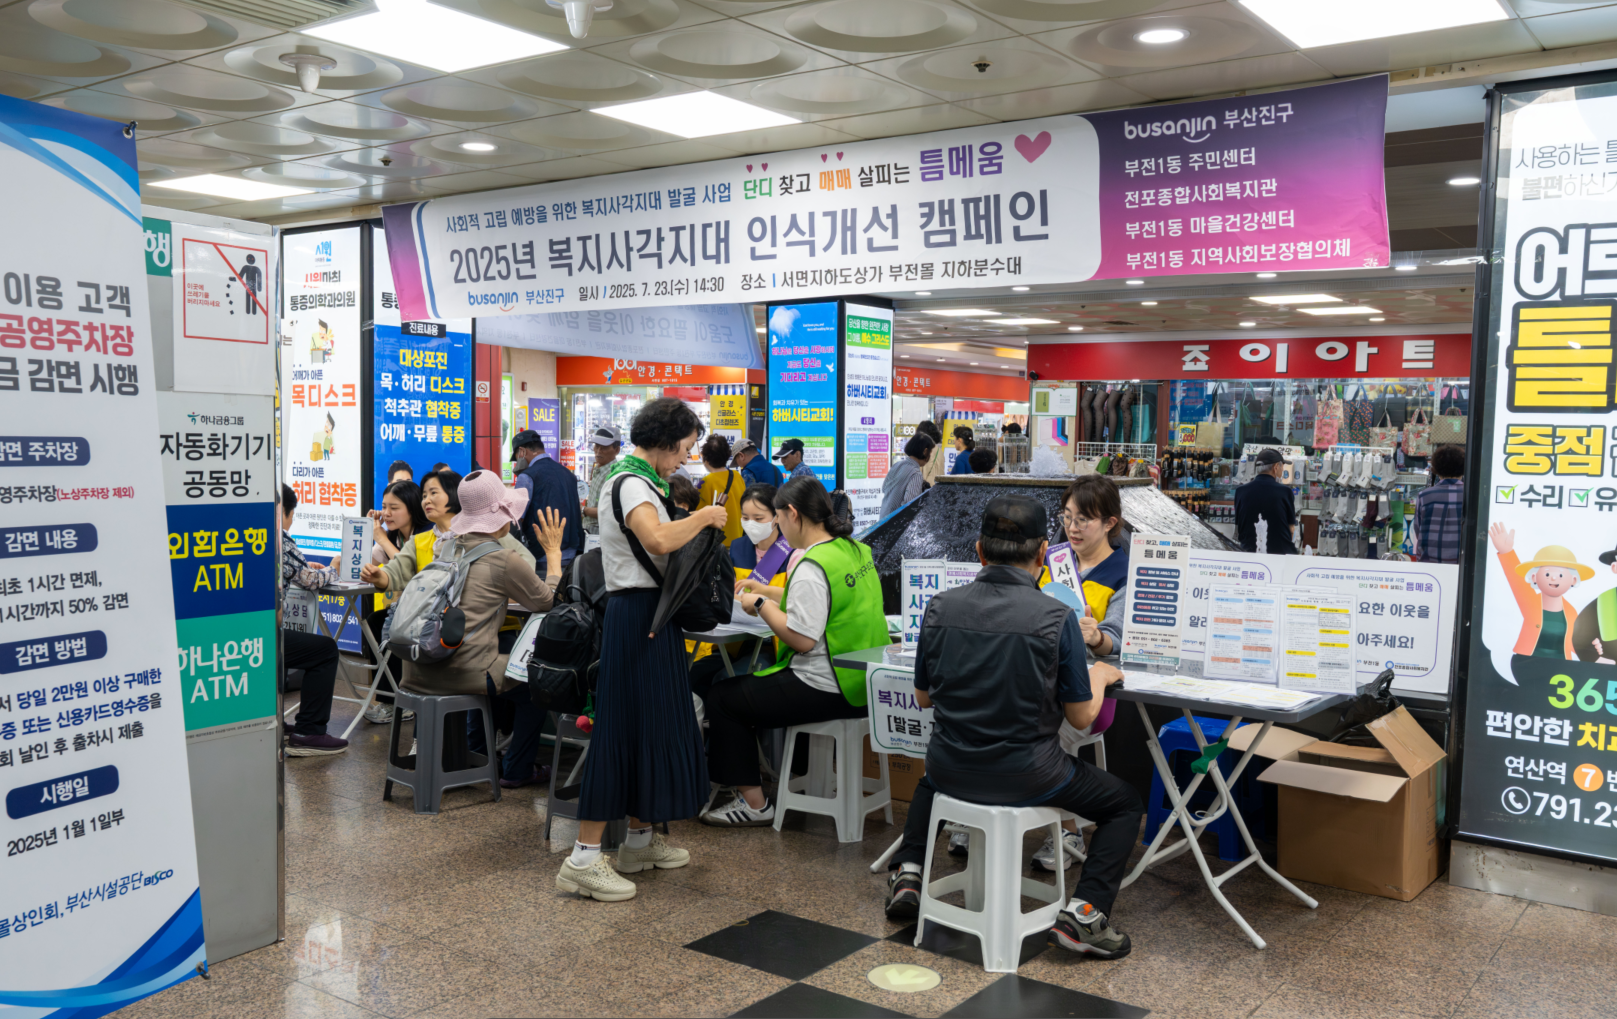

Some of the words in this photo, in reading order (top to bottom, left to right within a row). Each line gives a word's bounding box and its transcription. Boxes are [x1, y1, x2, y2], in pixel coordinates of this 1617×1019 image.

[1124, 115, 1217, 140] busanjin
[1223, 102, 1294, 129] 부산진구
[1125, 155, 1182, 177] 부전1동
[1188, 147, 1256, 172] 주민센터
[1515, 142, 1600, 169] 사용하는
[743, 177, 773, 200] 단디
[779, 173, 811, 196] 찾고
[819, 168, 852, 191] 매매
[857, 162, 910, 188] 살피는
[919, 141, 1004, 182] 틈메움
[1124, 177, 1278, 209] 전포종합사회복지관
[446, 213, 480, 233] 사회적
[484, 210, 507, 228] 고립
[511, 205, 548, 226] 예방을
[552, 201, 577, 221] 위한
[582, 191, 662, 217] 복지사각지대
[667, 187, 696, 208] 발굴
[702, 182, 731, 204] 사업
[450, 240, 537, 284] 2025년
[548, 220, 730, 277] 복지사각지대
[747, 204, 899, 261] 인식개선
[918, 189, 1049, 249] 캠페인
[1126, 218, 1183, 240] 부전1동
[1190, 209, 1295, 234] 마을건강센터
[143, 229, 171, 268] 행
[1126, 249, 1184, 270] 부전1동
[1191, 238, 1351, 266] 지역사회보장협의체
[186, 282, 205, 291] 이곳에
[740, 272, 767, 291] 장소
[781, 265, 883, 289] 서면지하도상가
[888, 262, 934, 283] 부전몰
[940, 256, 1022, 279] 지하분수대
[3, 272, 64, 311] 이용
[77, 281, 132, 318] 고객
[186, 291, 210, 299] 쓰레기를
[290, 291, 356, 311] 통증의학과의원
[468, 291, 519, 308] busanjin
[525, 288, 565, 305] 부산진구
[578, 285, 599, 302] 일시
[609, 283, 638, 299] 2025.
[641, 282, 651, 296] 7.
[694, 276, 725, 293] 14:30
[409, 322, 439, 336] 진료내용
[400, 349, 448, 369] 대상포진
[1506, 301, 1617, 414] 틀
[28, 358, 83, 394] 감면
[90, 363, 139, 397] 시행
[430, 376, 465, 394] 디스크
[780, 371, 806, 382] 기다리고
[291, 384, 357, 408] 목디스크
[384, 398, 422, 418] 척추관
[426, 400, 461, 420] 협착증
[200, 415, 244, 426] 하나금융그룹
[533, 408, 555, 422] SALE
[772, 407, 834, 422] 하버시티교회!
[159, 432, 271, 461] 자동화기기
[442, 425, 465, 444] 통증
[28, 441, 79, 462] 주차장
[1503, 423, 1607, 477] 중점
[183, 469, 251, 498] 공동망
[292, 466, 311, 478] 다리가
[112, 485, 135, 499] 제외)
[292, 481, 316, 505] 허리
[318, 482, 357, 507] 협착증
[1519, 484, 1563, 509] 수리
[5, 531, 40, 553] 감면
[45, 528, 78, 549] 내용
[167, 527, 268, 560] 외환은행
[28, 573, 65, 593] 1시간
[69, 570, 103, 590] 면제,
[193, 562, 244, 592] ATM
[908, 573, 939, 590] 복지
[1241, 570, 1265, 581] 틈메움
[1405, 581, 1433, 593] 틈메움
[68, 597, 99, 614] 50%
[102, 592, 130, 611] 감면
[1389, 602, 1431, 619] 이웃을
[15, 642, 50, 666] 감면
[54, 637, 88, 660] 방법
[177, 637, 264, 676] 하나은행
[16, 688, 47, 710] 당일
[51, 681, 88, 703] 2만원
[93, 675, 120, 694] 이상
[124, 668, 162, 689] 구매한
[190, 672, 249, 703] ATM
[21, 716, 52, 736] 또는
[56, 692, 162, 728] 신용카드영수증을
[1486, 709, 1573, 746] 편안한
[18, 742, 49, 764] 날인
[53, 737, 69, 756] 후
[72, 727, 114, 752] 출차시
[118, 721, 144, 740] 제출
[1504, 756, 1567, 785] 연산역
[1580, 768, 1597, 788] 7
[40, 776, 90, 804] 시행일
[7, 827, 58, 857] 2025년
[62, 819, 86, 839] 1월
[90, 808, 125, 838] 1일부
[65, 871, 143, 913] 부산시설공단
